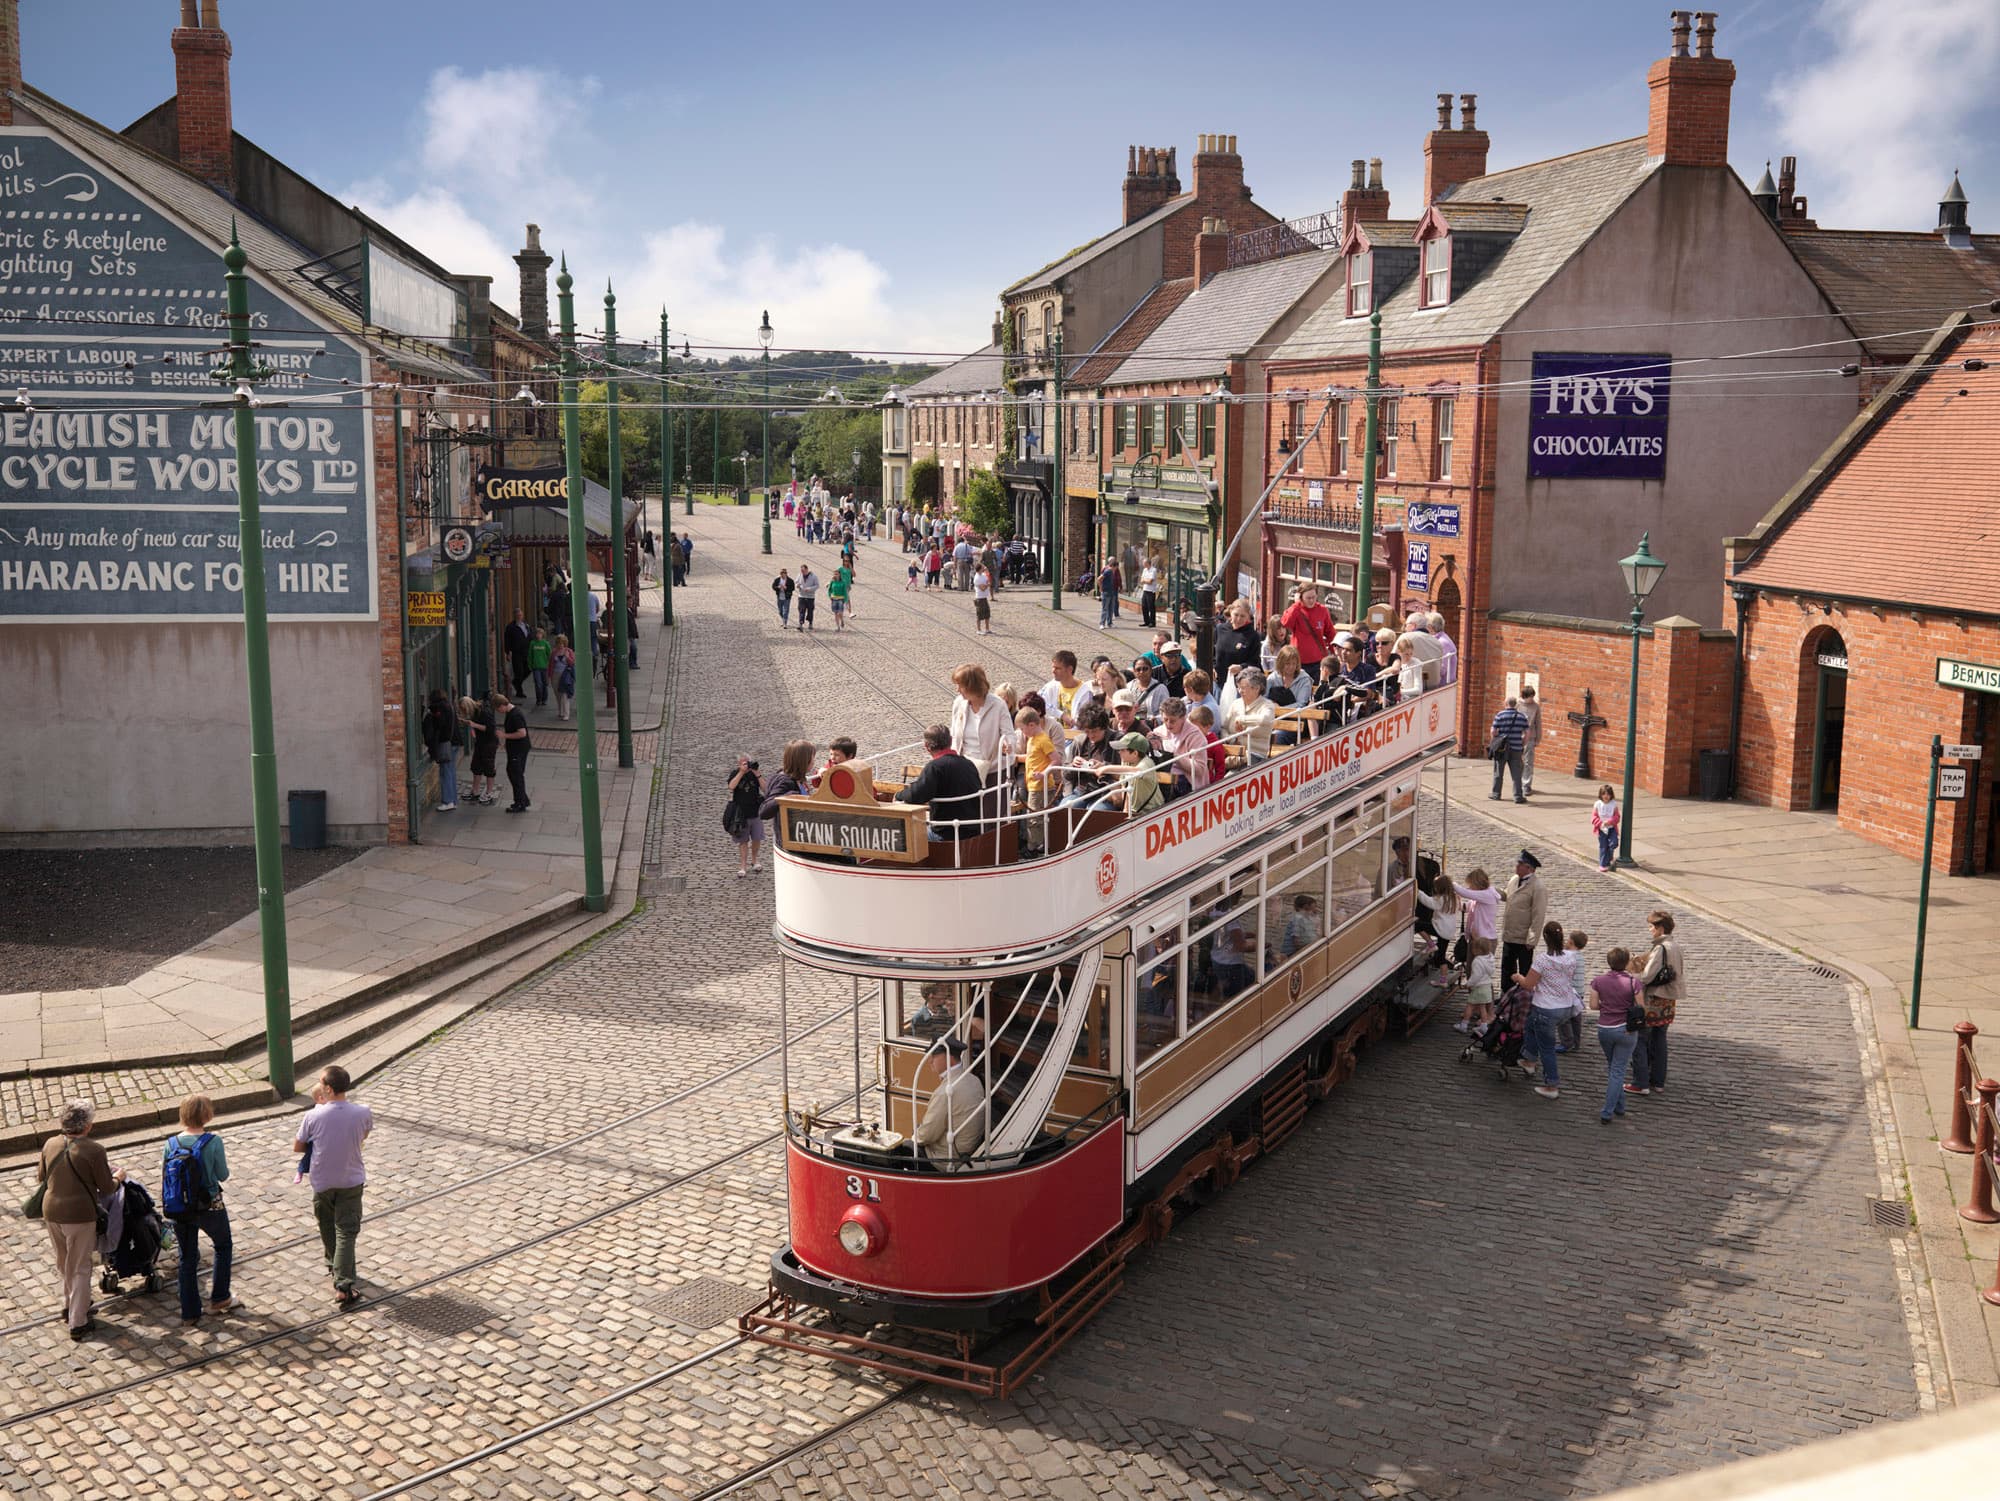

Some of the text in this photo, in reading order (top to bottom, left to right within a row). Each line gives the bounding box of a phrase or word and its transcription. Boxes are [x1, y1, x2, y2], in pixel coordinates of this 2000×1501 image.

[0, 175, 36, 198] ils
[43, 228, 60, 249] &
[64, 229, 167, 256] Acetylene
[89, 254, 137, 276] Sets
[33, 304, 156, 325] Accessories
[164, 305, 180, 325] &
[66, 350, 137, 364] LABOUR
[164, 351, 204, 366] FINE
[0, 369, 69, 384] SPECIAL
[74, 371, 135, 385] BODIES
[1546, 377, 1654, 415] FRY'S
[0, 412, 172, 450] EAMISH
[1533, 436, 1662, 456] CHOCOLATES
[2, 454, 138, 490] CYCLE
[24, 527, 64, 550] Any
[69, 527, 118, 546] make
[122, 527, 143, 551] of
[144, 532, 177, 547] new
[182, 534, 214, 548] car
[205, 562, 267, 592] FO
[279, 563, 349, 593] HIRE
[1952, 663, 2000, 688] BEAMIS
[1146, 707, 1416, 860] DARLINGTON BUILDING SOCIETY
[1943, 774, 1964, 782] TRAM
[1225, 814, 1254, 839] Looking
[1259, 804, 1275, 821] after
[1279, 791, 1295, 811] local
[1299, 779, 1327, 800] interests
[1330, 770, 1346, 786] since
[795, 820, 834, 846] GYNN
[1101, 859, 1115, 884] 150
[846, 1175, 881, 1203] 31
